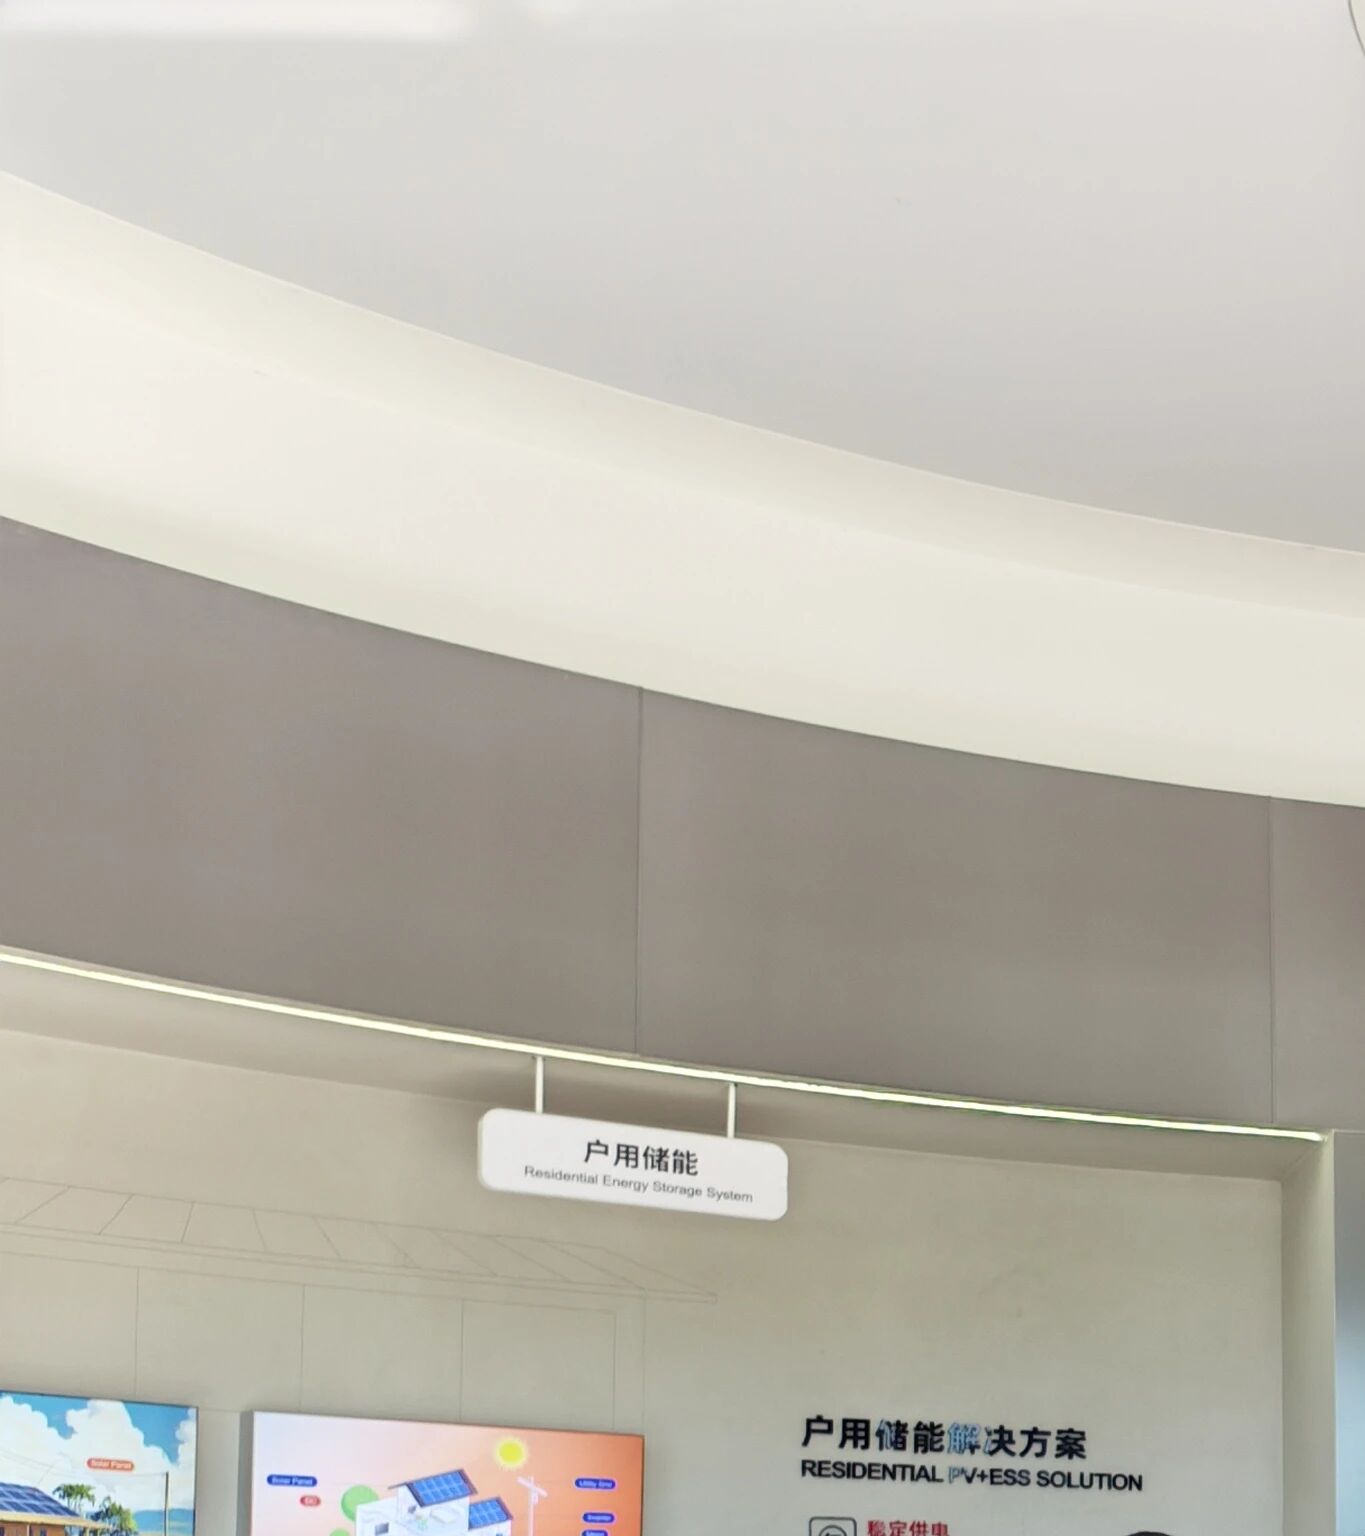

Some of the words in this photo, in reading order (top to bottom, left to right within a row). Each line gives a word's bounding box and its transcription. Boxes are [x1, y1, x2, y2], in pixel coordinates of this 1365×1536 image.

[584, 1139, 699, 1177] 户用储能
[524, 1165, 598, 1185] Residential
[603, 1175, 649, 1193] Energy
[653, 1181, 702, 1198] Storage
[707, 1187, 753, 1203] System
[801, 1415, 1088, 1460] 户用储能解决方案
[801, 1459, 944, 1483] RESIDENTIAL
[949, 1465, 1031, 1487] PV+ESS
[1036, 1470, 1143, 1491] SOLUTION
